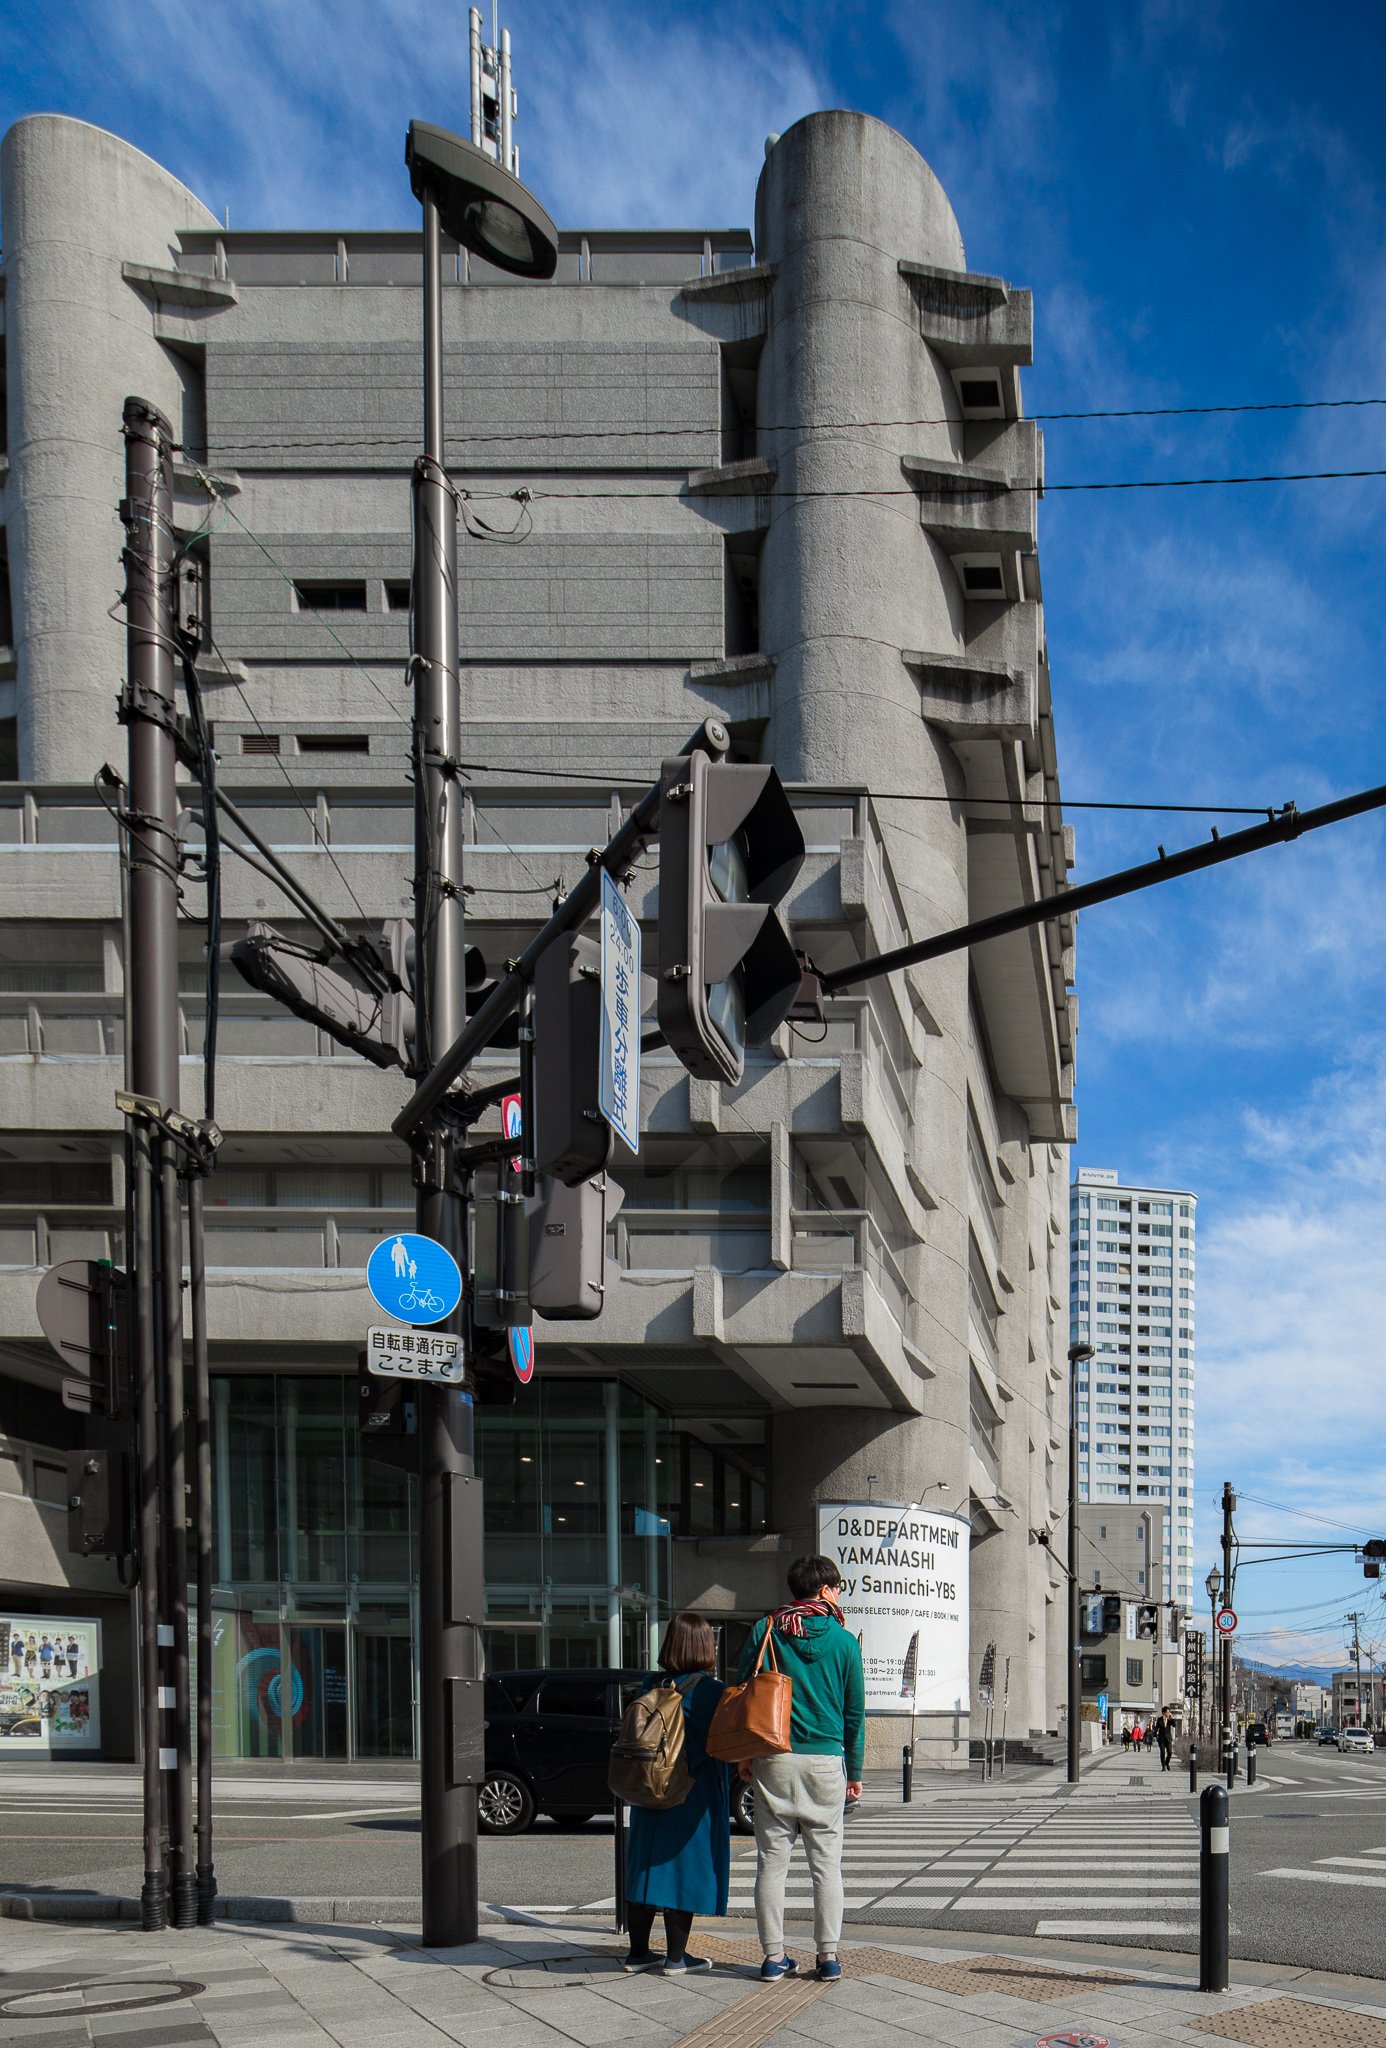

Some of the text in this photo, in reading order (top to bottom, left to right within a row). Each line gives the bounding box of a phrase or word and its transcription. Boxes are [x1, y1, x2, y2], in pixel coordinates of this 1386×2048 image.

[612, 895, 632, 938] 6:00
[610, 922, 634, 974] 24:00
[613, 960, 629, 1130] 歩車分離式
[372, 1331, 459, 1358] 自転車通行可
[378, 1355, 454, 1377] ここまで
[838, 1518, 959, 1549] D&DEPARTMENT
[837, 1546, 935, 1570] YAMANASHI
[862, 1575, 956, 1601] Sannichi-YBS
[865, 1606, 890, 1615] SELECT
[892, 1608, 909, 1616] SHOP
[915, 1609, 929, 1618] CAFE
[1221, 1615, 1233, 1627] 30
[1187, 1632, 1196, 1683] 甲州夢小路
